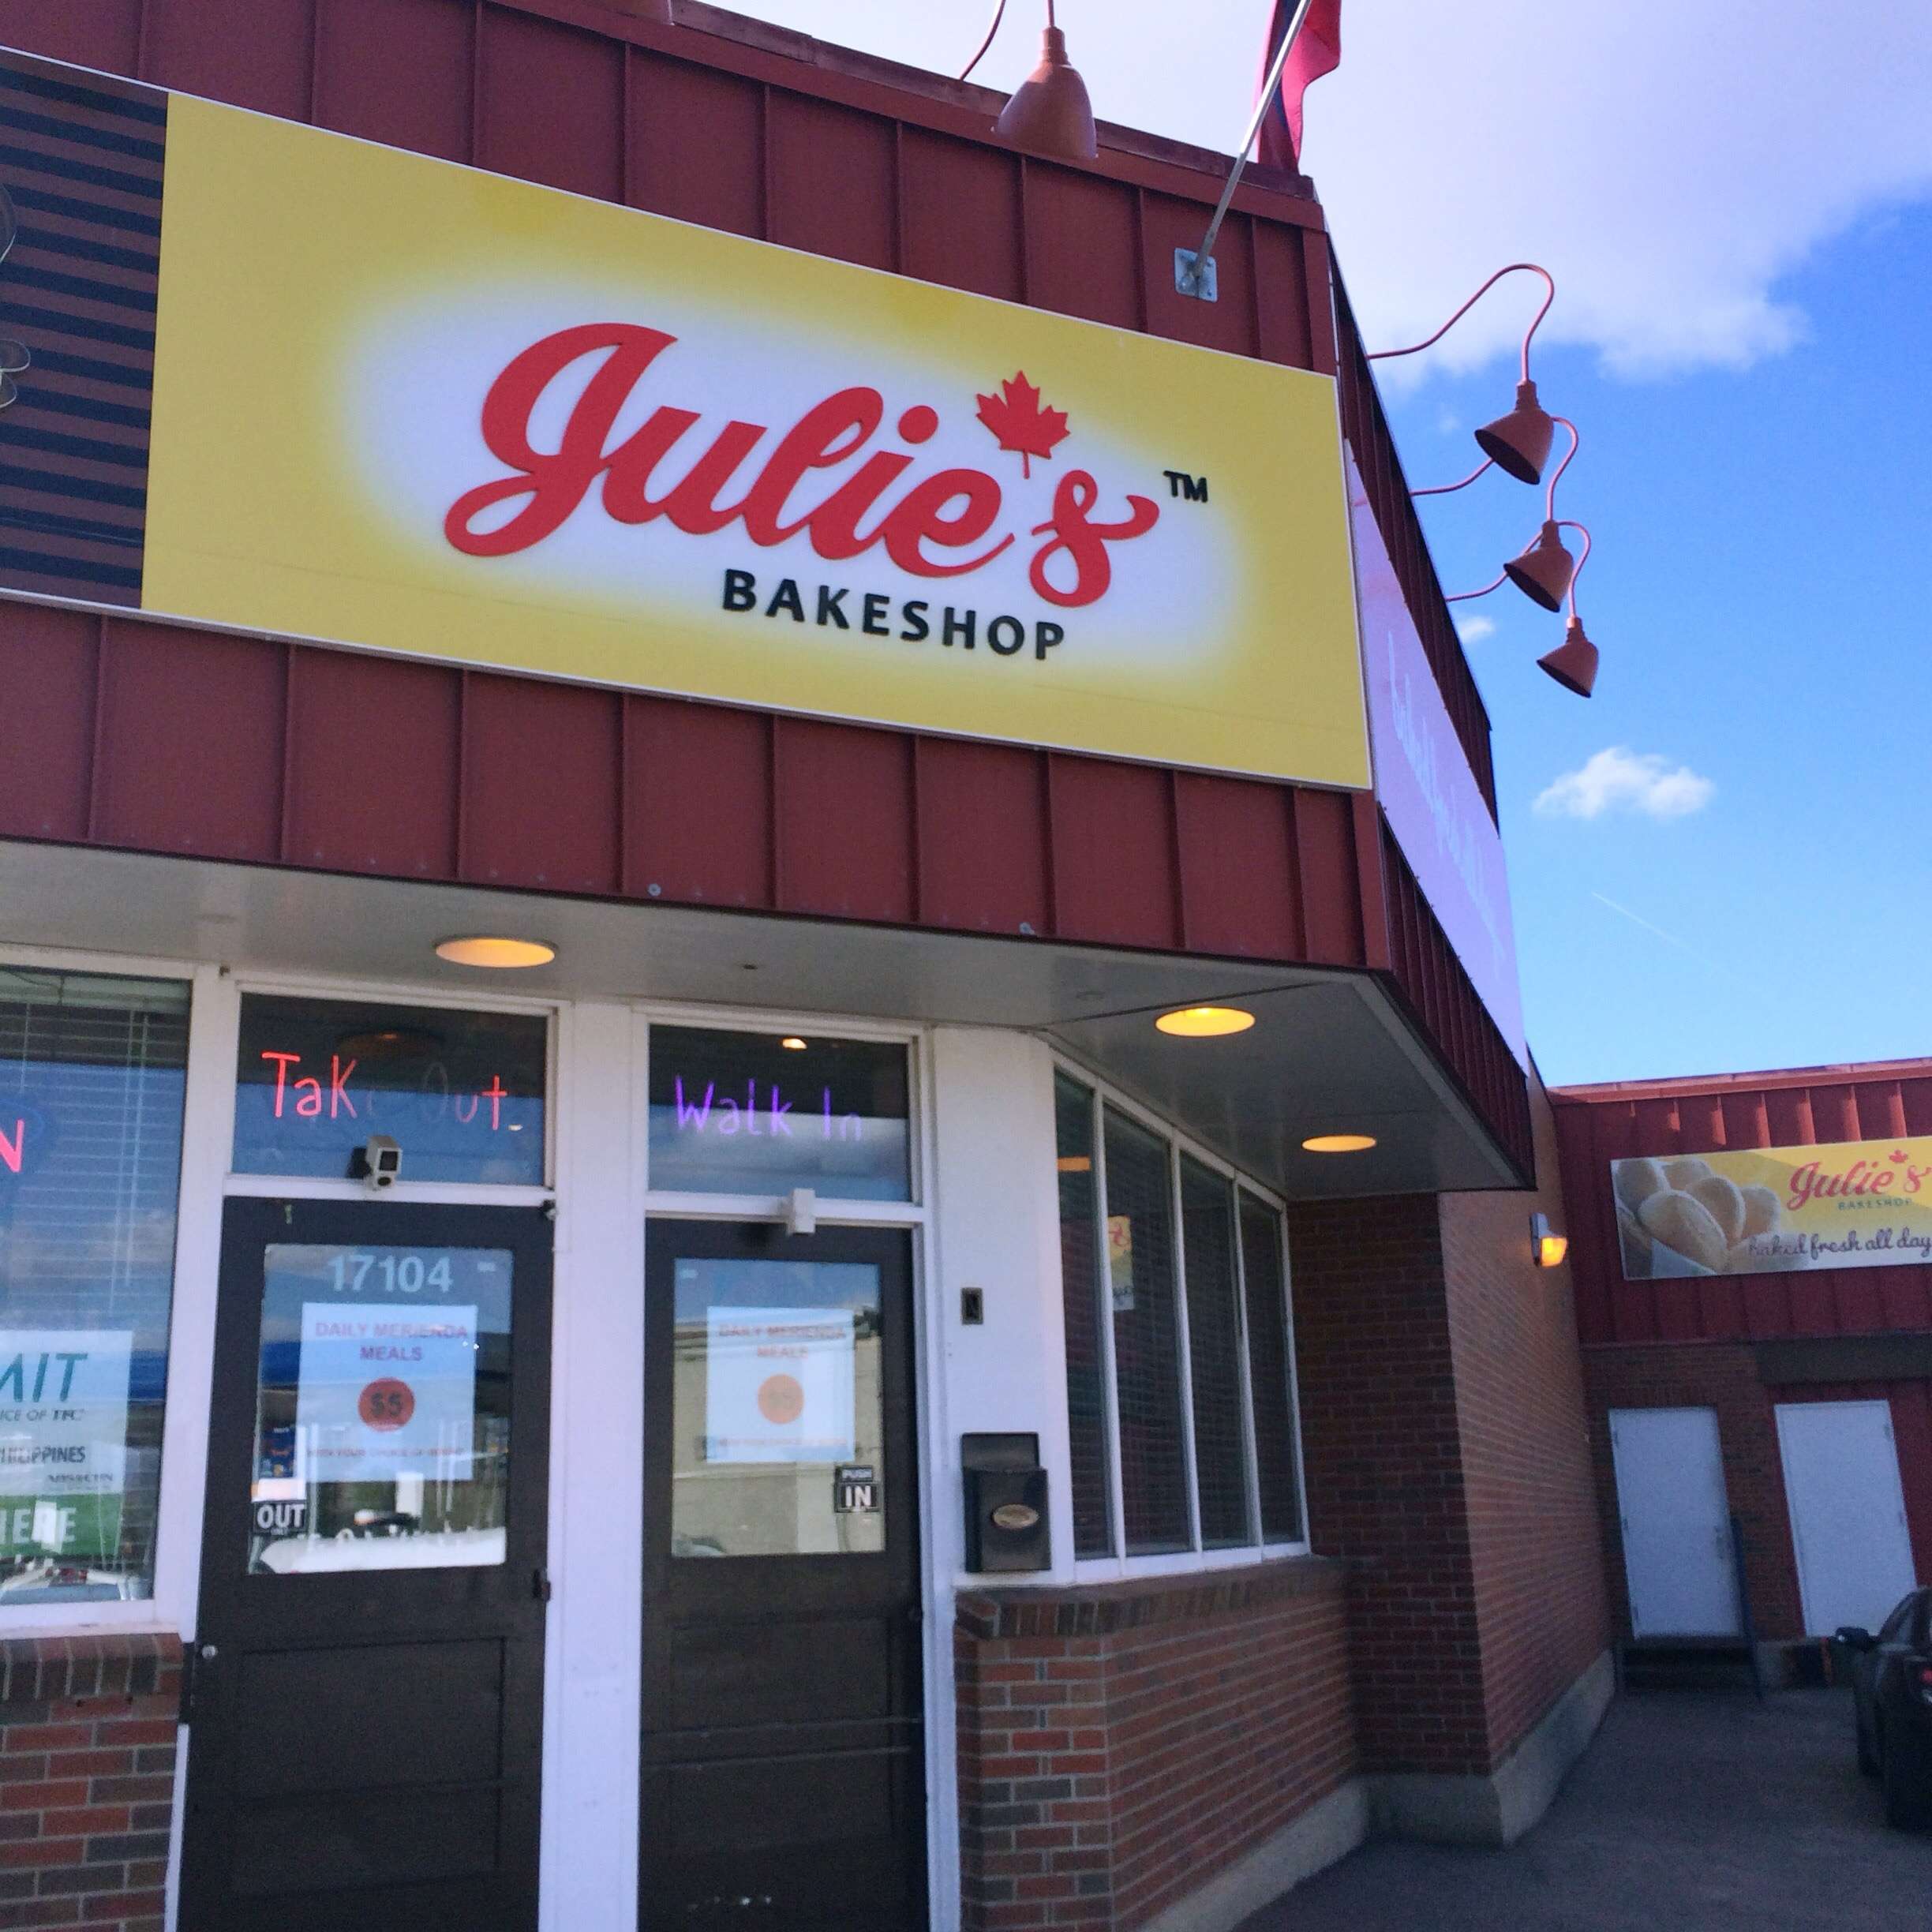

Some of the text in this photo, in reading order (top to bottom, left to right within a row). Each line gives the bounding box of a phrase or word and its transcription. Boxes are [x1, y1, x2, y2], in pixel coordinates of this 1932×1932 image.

[444, 323, 1159, 607] Julie's
[722, 568, 1065, 660] BAKESHOP
[675, 1074, 793, 1137] Walk
[1837, 1197, 1913, 1211] BAKESHOP
[1810, 1230, 1863, 1261] fresh
[1866, 1226, 1893, 1251] all
[1896, 1226, 1932, 1258] day
[328, 1255, 453, 1294] 17104
[359, 1346, 423, 1361] MEALS
[845, 1485, 871, 1507] IN
[256, 1503, 305, 1530] OUT
